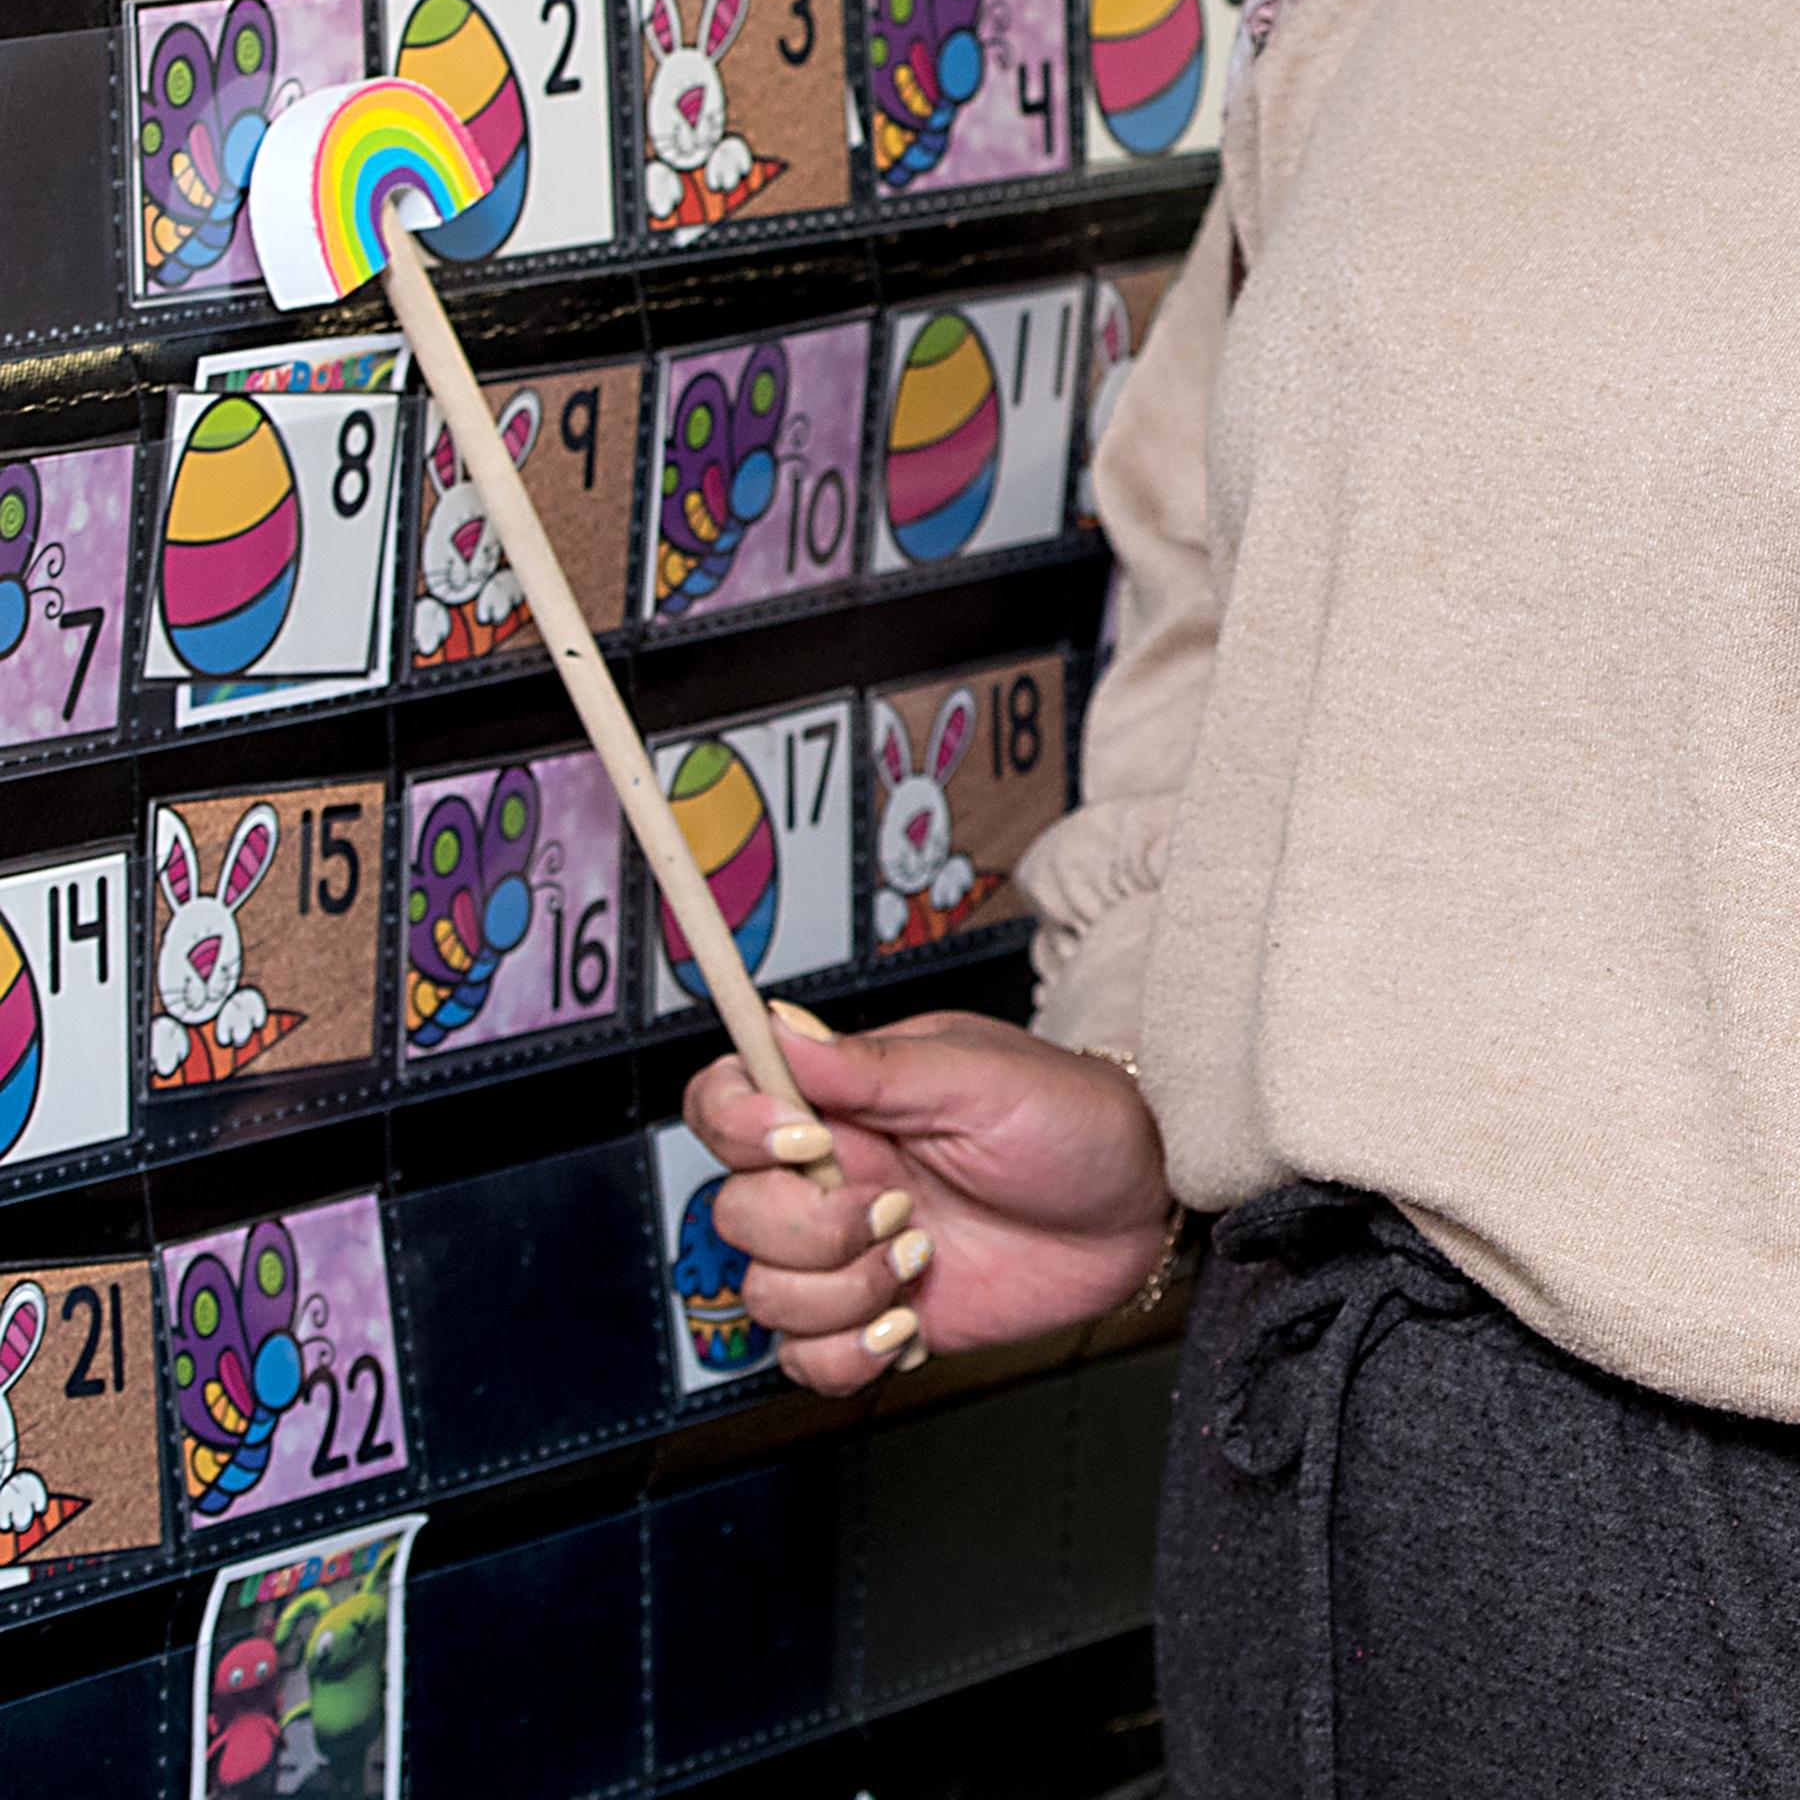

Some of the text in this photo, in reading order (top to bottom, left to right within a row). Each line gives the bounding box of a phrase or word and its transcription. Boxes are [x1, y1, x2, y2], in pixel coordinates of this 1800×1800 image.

[1017, 59, 1056, 156] 4
[58, 303, 1071, 722] 7 8 9 10 11
[49, 673, 1042, 1011] 14 15 16 17 18
[60, 1283, 395, 1480] 21 22
